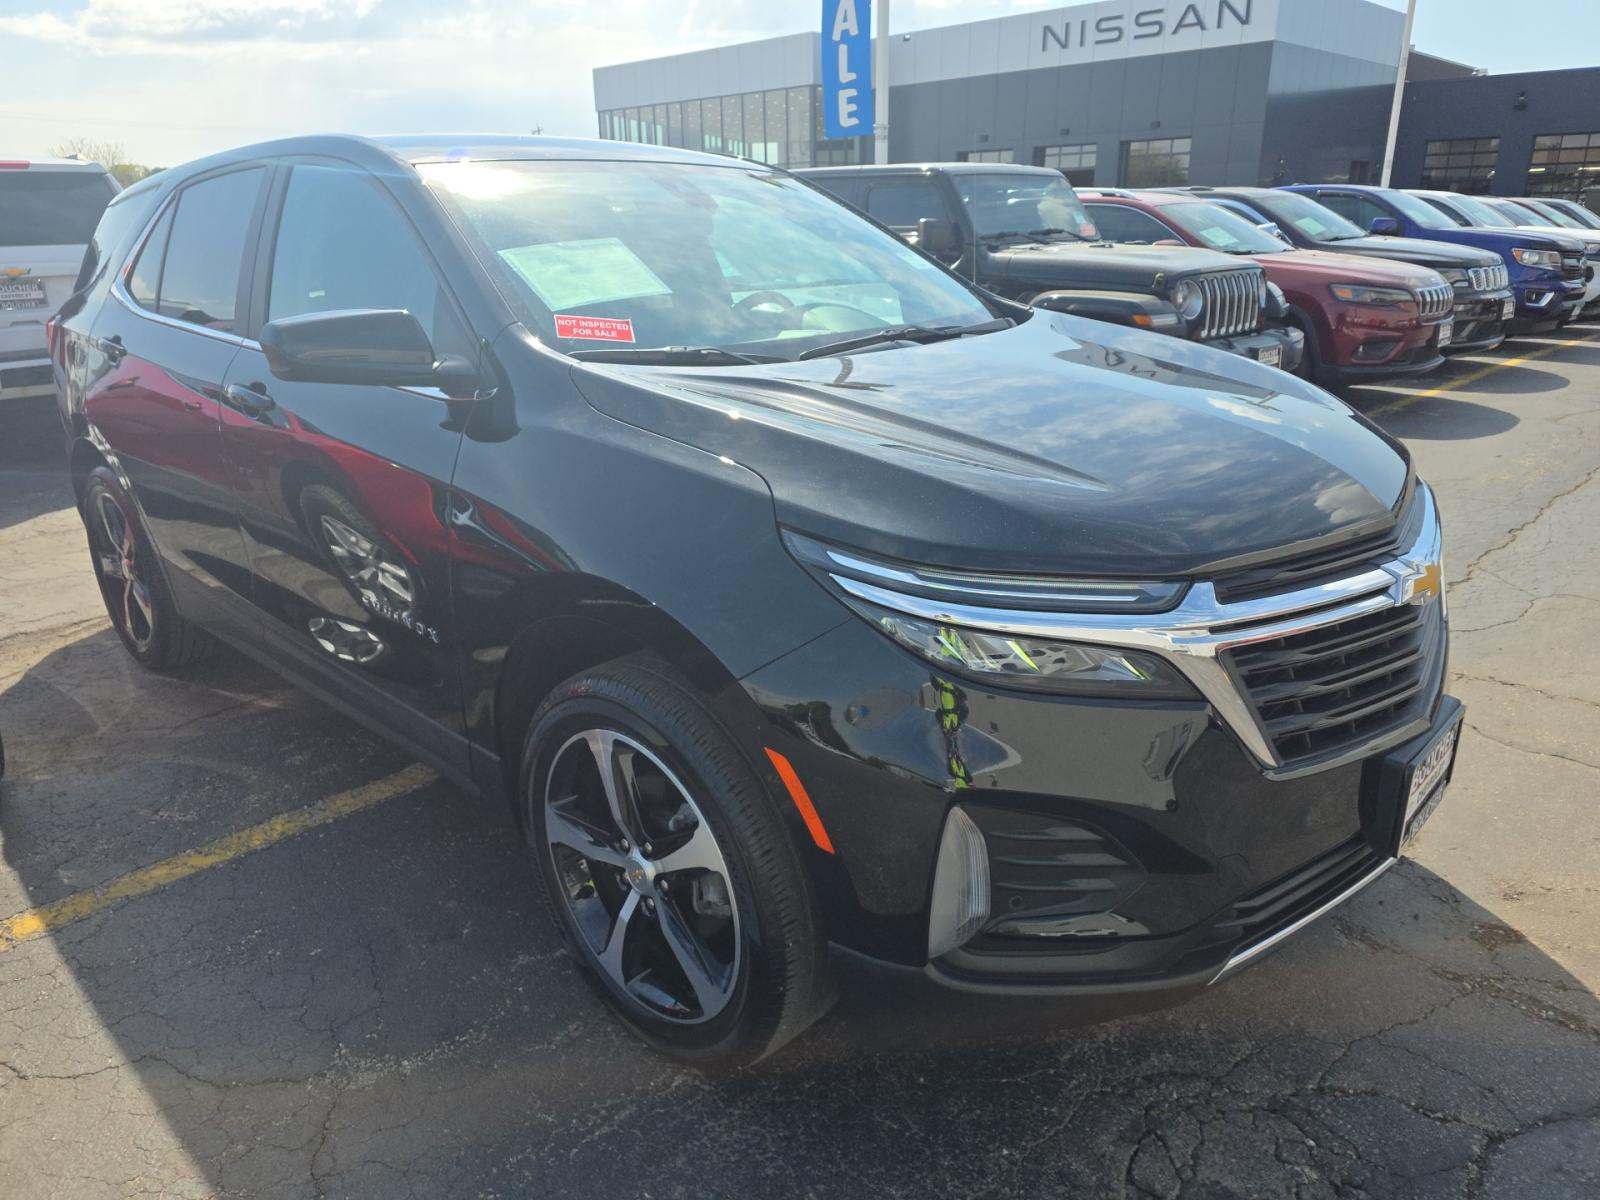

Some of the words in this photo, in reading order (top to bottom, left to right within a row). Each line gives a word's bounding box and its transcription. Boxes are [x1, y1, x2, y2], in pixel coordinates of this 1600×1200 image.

[1041, 0, 1252, 52] NISSAN
[579, 320, 629, 331] INSPECTED
[572, 328, 593, 336] FOR
[595, 329, 618, 337] SALE
